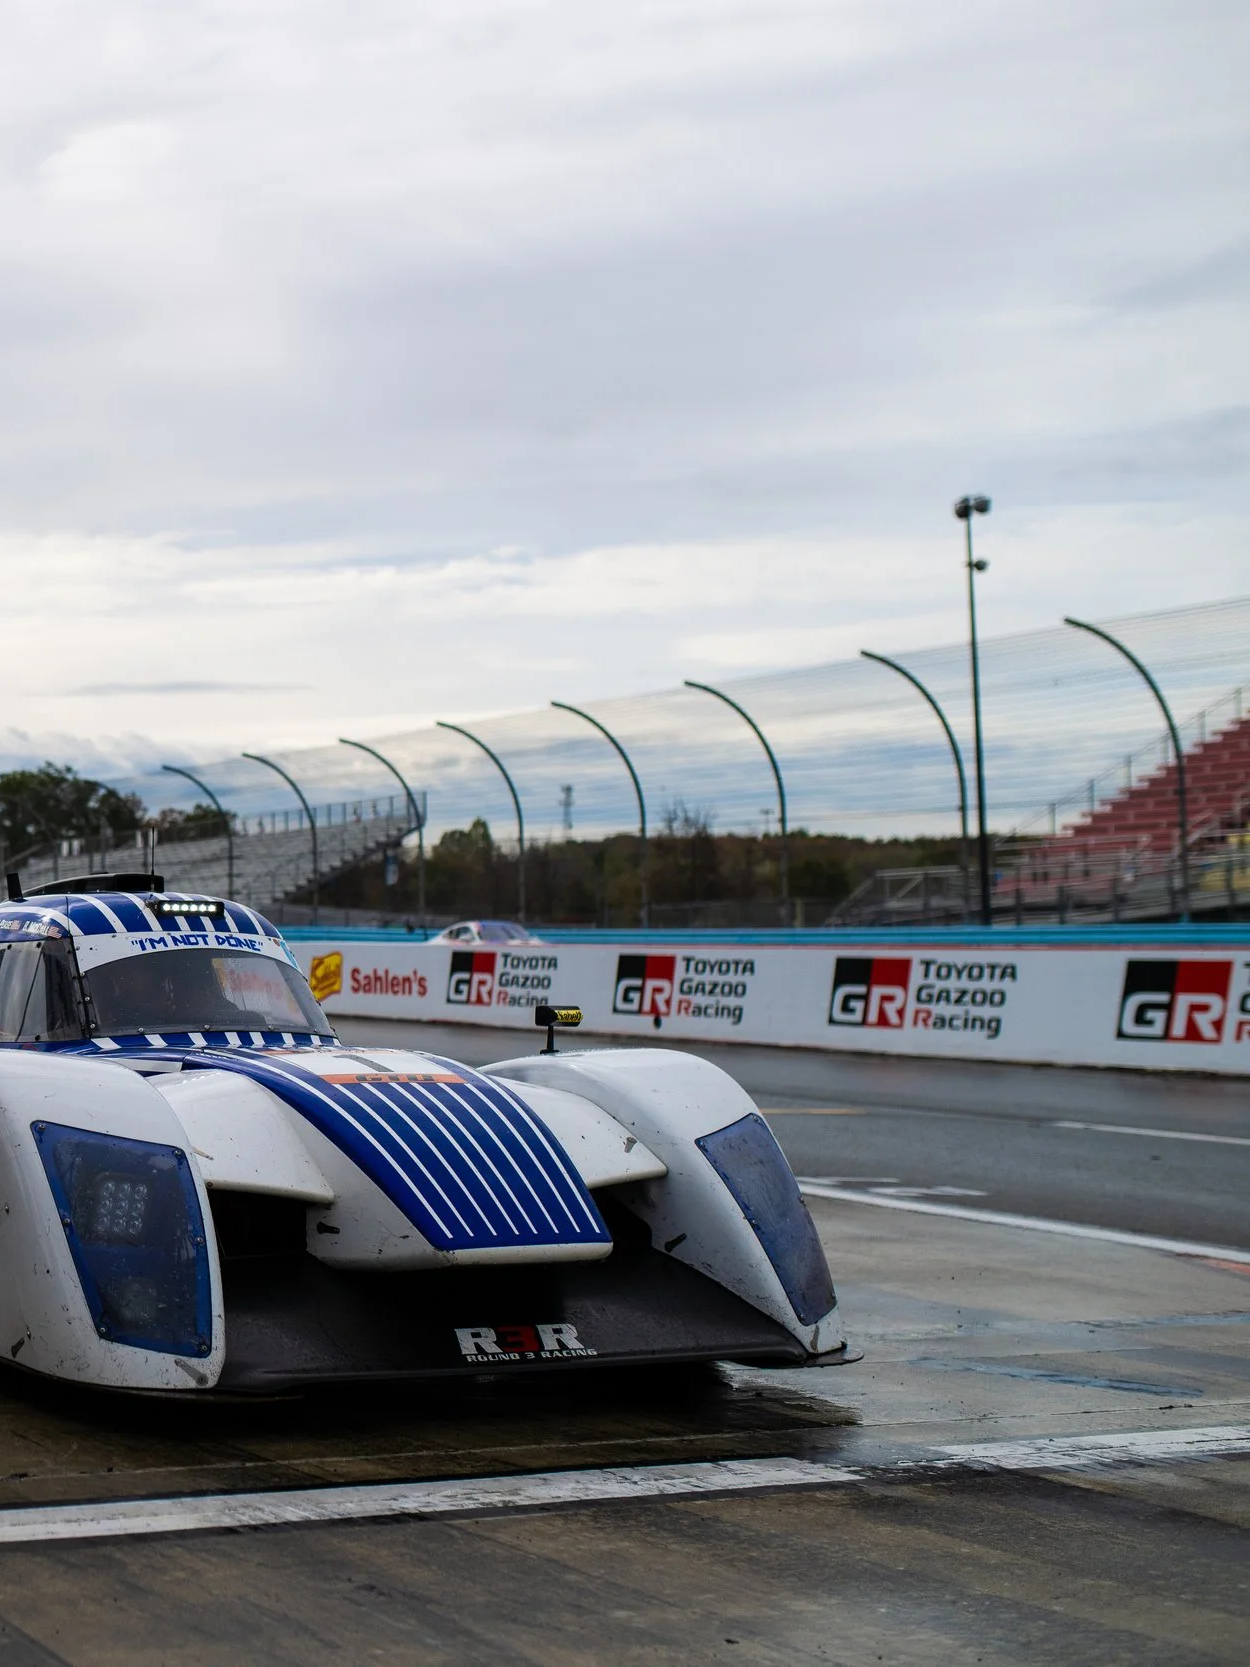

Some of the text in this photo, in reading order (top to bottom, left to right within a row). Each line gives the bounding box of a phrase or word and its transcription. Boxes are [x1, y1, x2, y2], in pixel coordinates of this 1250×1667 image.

[170, 934, 209, 946] NOT
[501, 952, 558, 970] TOYOTA
[682, 956, 755, 976] TOYOTA
[920, 959, 1017, 982] TOYOTA
[351, 967, 427, 998] Sahlen's
[448, 972, 494, 1006] GR
[498, 972, 552, 989] GAZOO
[679, 978, 747, 998] GAZOO
[615, 978, 672, 1016] GR
[831, 984, 907, 1026] GR
[916, 984, 1006, 1007] GAZOO
[677, 998, 743, 1026] Racing
[913, 1008, 1002, 1039] Racing
[1120, 992, 1226, 1042] GR
[454, 1323, 585, 1355] R3R
[466, 1348, 598, 1363] ROUND 3 RACING
